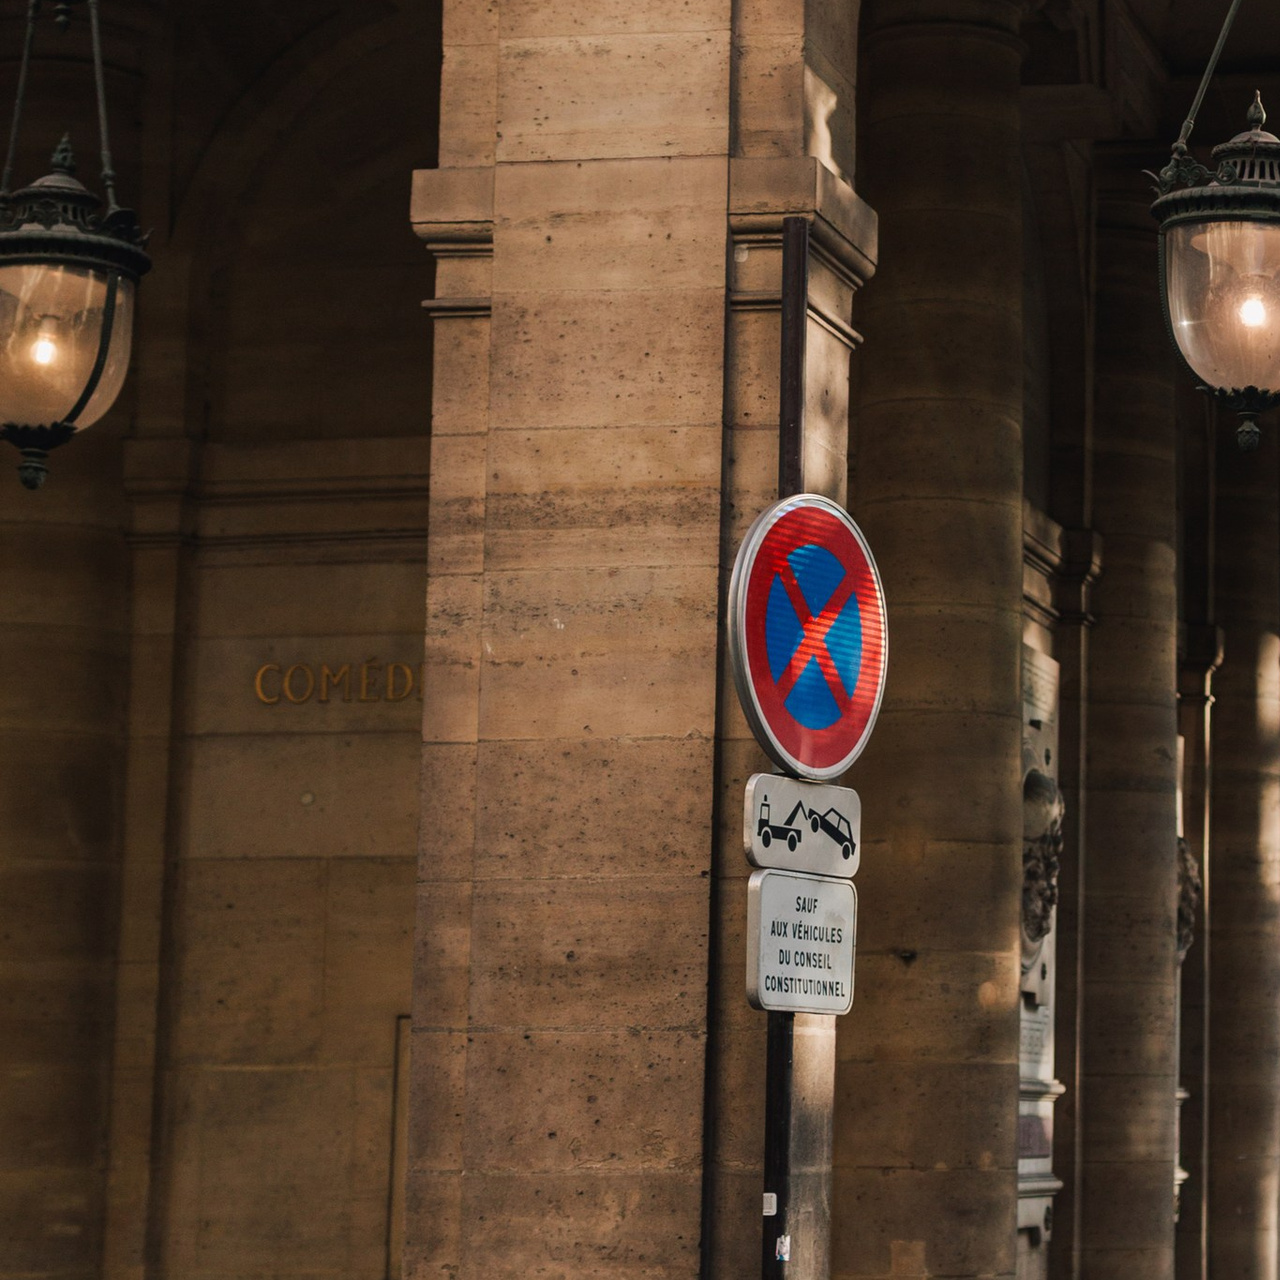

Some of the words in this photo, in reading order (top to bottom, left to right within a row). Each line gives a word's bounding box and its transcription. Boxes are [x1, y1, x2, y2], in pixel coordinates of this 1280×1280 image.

[795, 896, 818, 914] SAUF
[770, 920, 788, 938] AUX
[792, 920, 843, 944] VÉHICULES
[778, 949, 791, 965] DU
[794, 950, 832, 970] CONSEIL
[765, 975, 846, 998] CONSTITUTIONNEL
